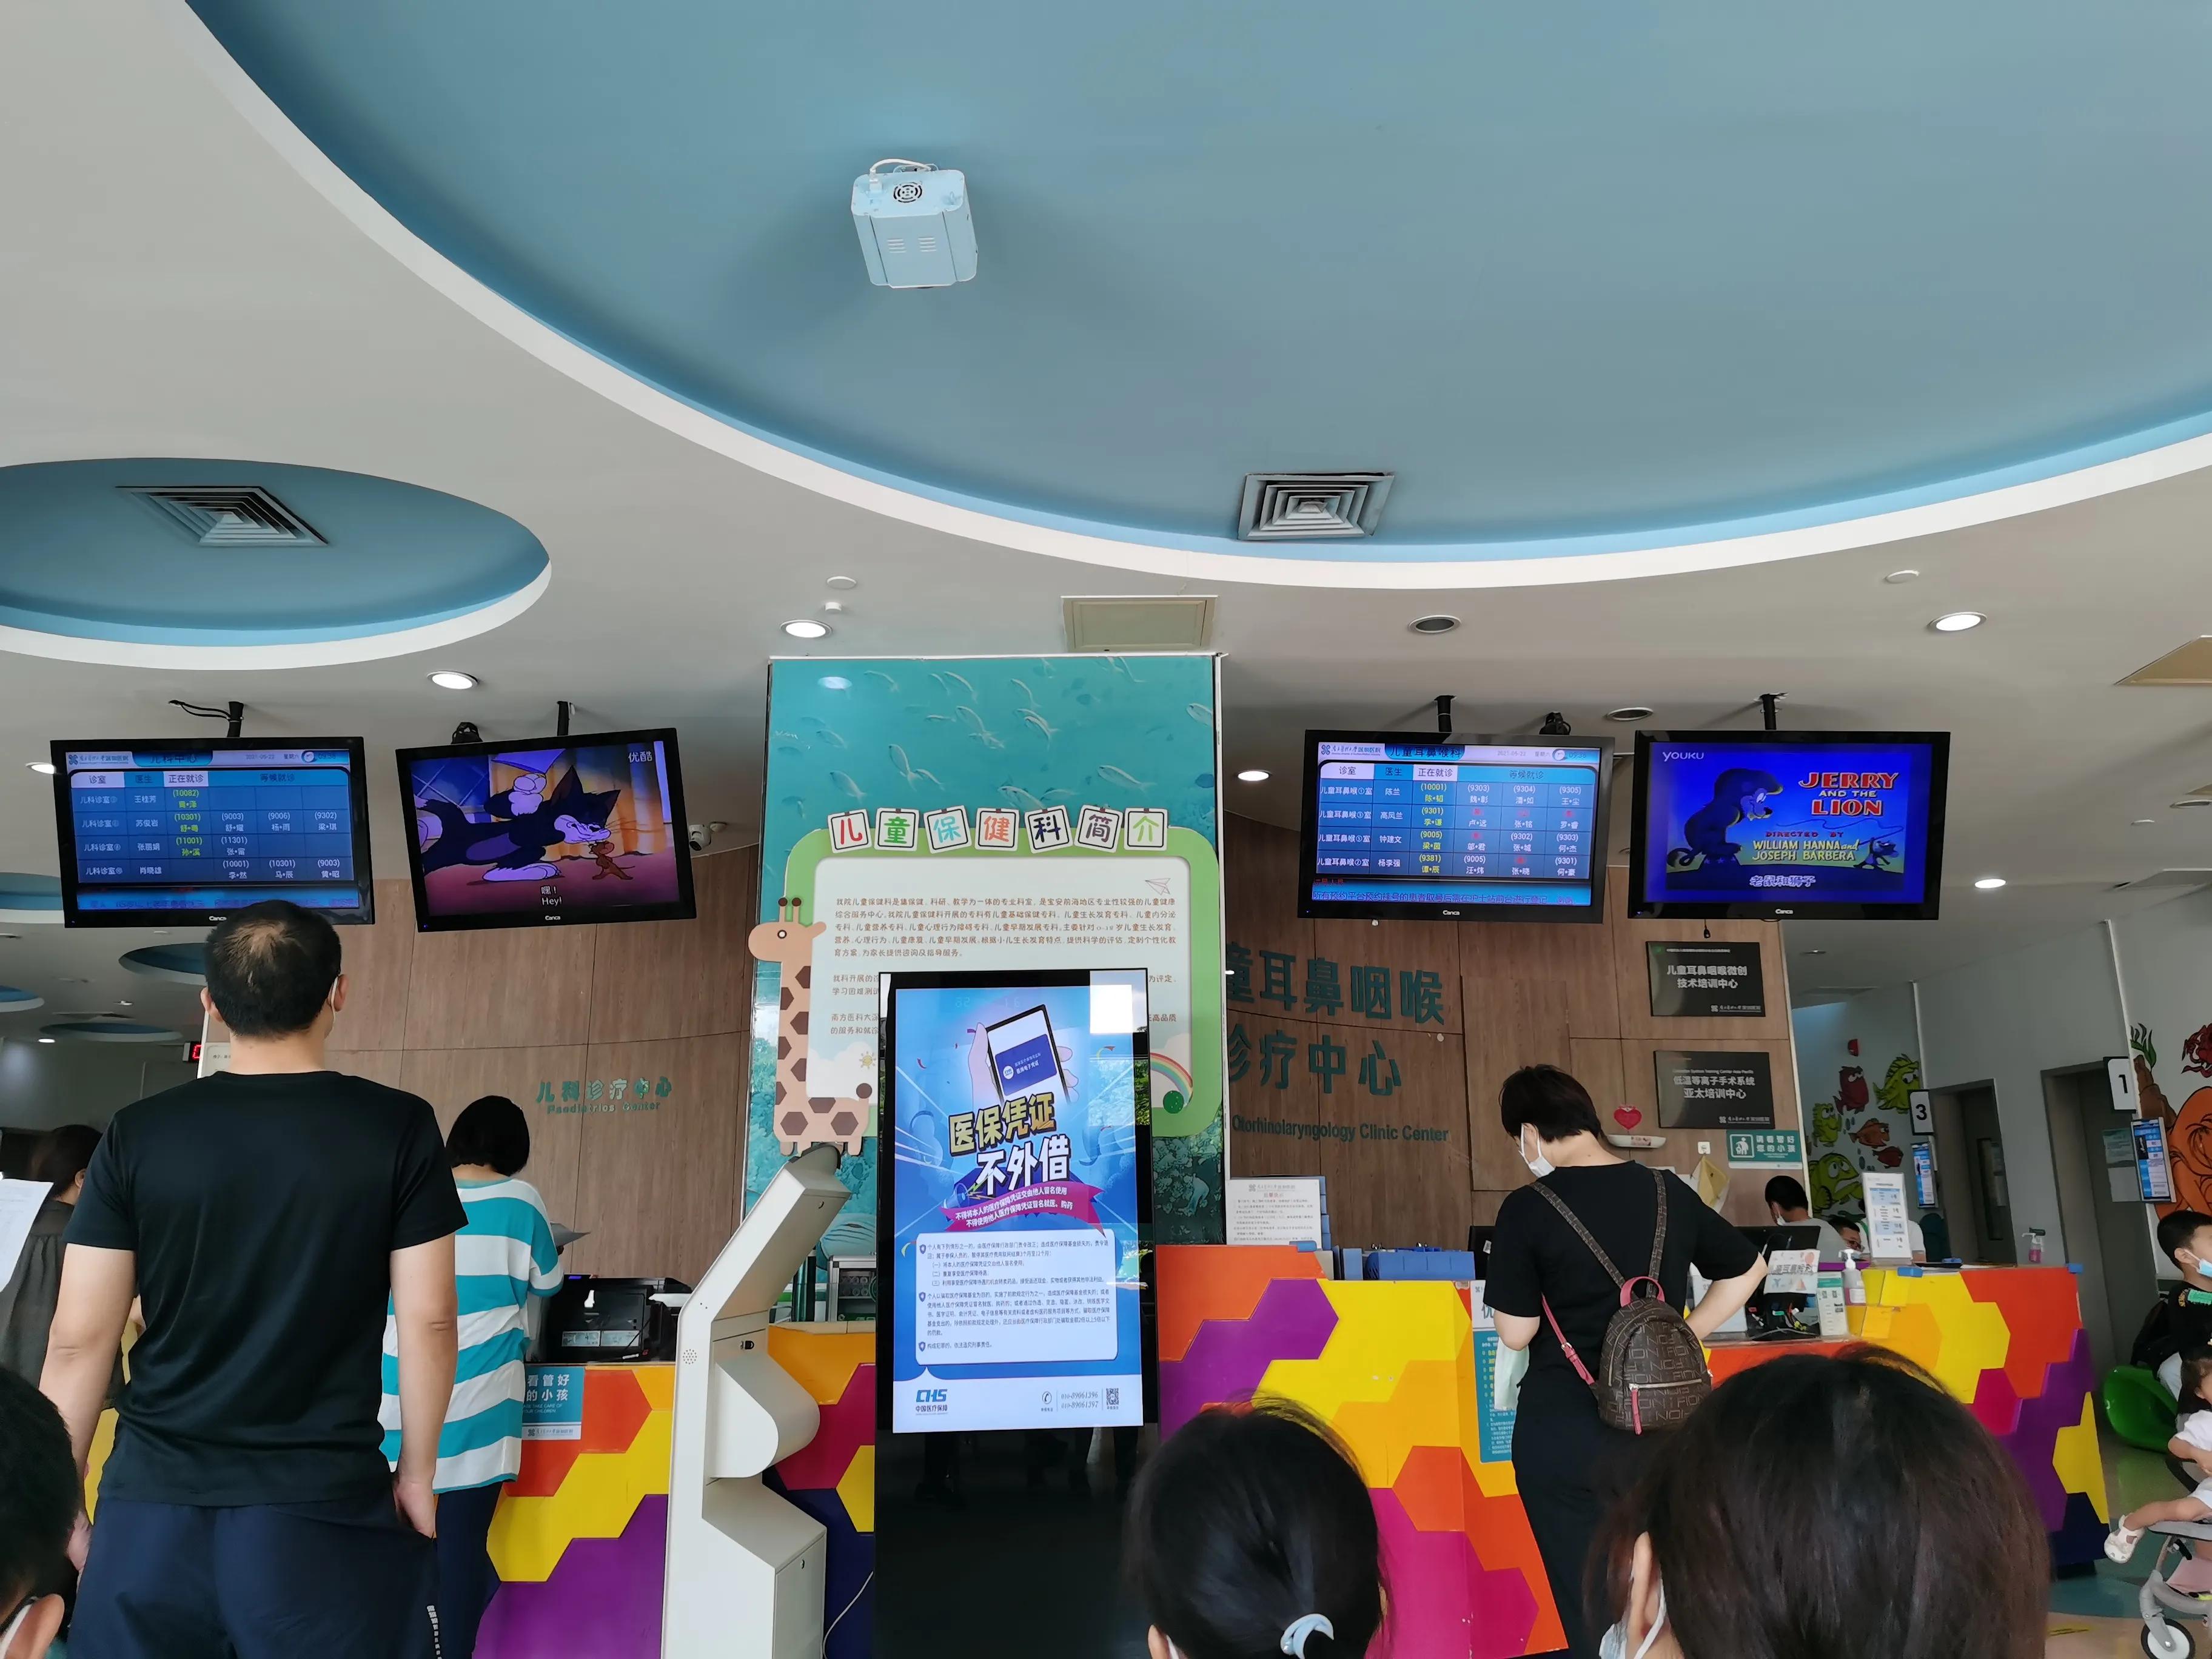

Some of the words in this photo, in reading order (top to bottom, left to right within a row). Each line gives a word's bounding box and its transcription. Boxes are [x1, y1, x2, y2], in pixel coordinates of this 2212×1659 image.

[628, 751, 652, 763] 优酷
[1390, 746, 1462, 758] 儿童耳鼻喉科
[1662, 751, 1704, 762] YOUKU
[1339, 766, 1356, 775] 诊室
[1385, 767, 1403, 776] 医生
[1418, 768, 1453, 777] 正在就诊
[89, 775, 106, 784] 诊室
[135, 775, 153, 783] 医生
[169, 774, 203, 783] 正在就诊
[1798, 772, 1899, 789] JERRY
[1513, 785, 1535, 794] (9304)
[1811, 800, 1884, 816] LION
[315, 811, 337, 820] (9302)
[840, 814, 1159, 846] 儿童保健科简介
[1420, 831, 1443, 839] (9005)
[221, 836, 247, 845] (11301)
[1510, 833, 1533, 841] (9302)
[1557, 833, 1578, 842] (9303)
[1752, 840, 1799, 851] WILLIAM
[1803, 840, 1840, 850] HANNA
[1840, 839, 1860, 851] and
[1464, 855, 1486, 863] (9005)
[1555, 857, 1577, 865] (9301)
[1752, 850, 1796, 861] JOSEPH
[1803, 850, 1855, 862] BARBERA
[223, 860, 249, 868] (10001)
[269, 859, 295, 868] (10301)
[317, 859, 340, 868] (9003)
[1749, 875, 1817, 888] 老鼠和狮子
[541, 897, 563, 907] Hey!
[1226, 942, 1445, 1025] 童耳鼻咽喉
[1677, 978, 1738, 988] 技术培训中心
[1228, 1023, 1402, 1096] 诊疗中心
[2118, 1074, 2129, 1094] 1
[536, 1076, 672, 1104] 儿科诊疗中心
[1684, 1088, 1746, 1099] 亚太培训中心
[1915, 1104, 1928, 1121] 3
[949, 1093, 1056, 1156] 医保凭证
[1232, 1114, 1356, 1142] Otorhinolaryngology
[1359, 1122, 1398, 1141] Clinic
[1402, 1125, 1450, 1142] Center
[976, 1135, 1070, 1196] 不外借
[528, 1374, 570, 1387] 看管好
[526, 1389, 569, 1401] 的小孩
[916, 1389, 948, 1403] CHS
